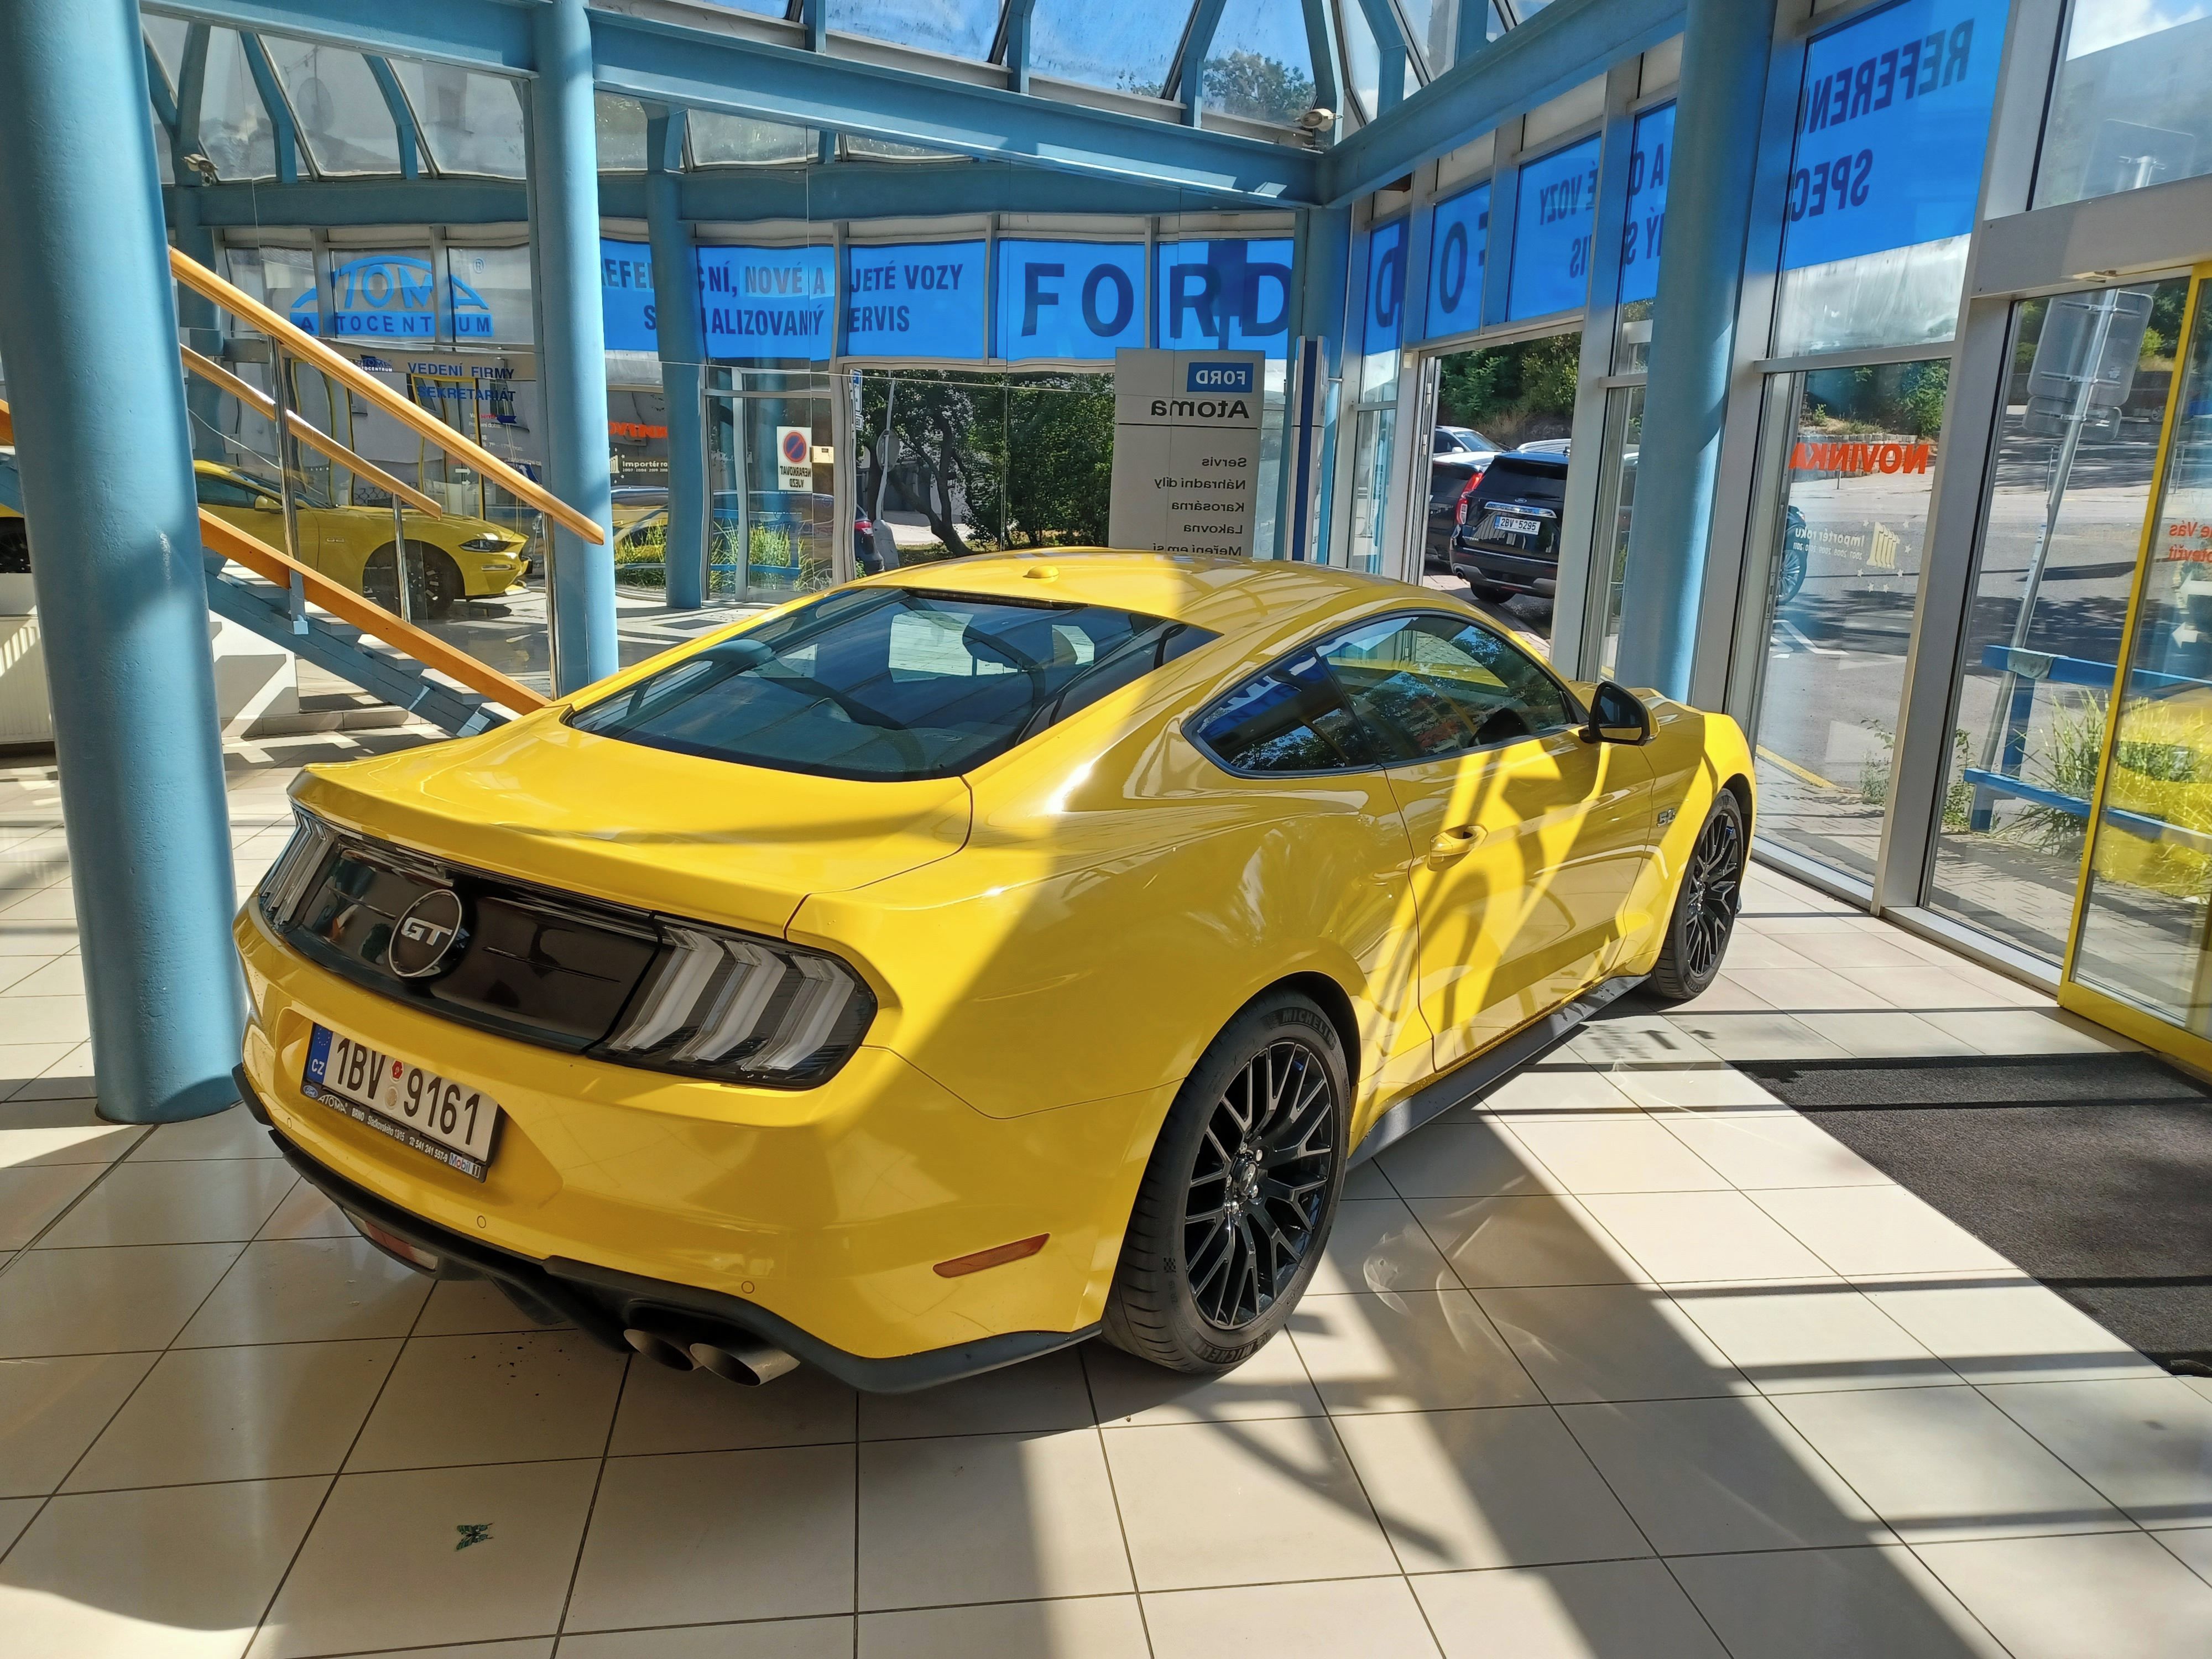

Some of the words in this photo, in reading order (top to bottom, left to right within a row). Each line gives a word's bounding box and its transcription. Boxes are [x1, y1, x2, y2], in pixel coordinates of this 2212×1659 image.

[745, 261, 803, 294] NOVÉ
[813, 267, 826, 295] A
[850, 260, 896, 293] JETÉ
[904, 263, 963, 290] VOZY
[1021, 262, 1292, 339] FORD
[299, 315, 491, 333] ATOCENTUM
[849, 305, 910, 333] ERVIS
[408, 361, 462, 377] VEDENÍ
[471, 366, 514, 379] FIRMY
[418, 385, 516, 401] SEKRETARIÁT
[1500, 518, 1515, 528] 2BV
[1519, 520, 1537, 531] 5295
[400, 917, 453, 946] GT
[1282, 1008, 1338, 1048] MICHELIN
[311, 1058, 325, 1076] CZ
[337, 1037, 387, 1100] 1BV
[404, 1068, 481, 1146] 9161
[317, 1094, 347, 1114] ATOMA
[351, 1108, 365, 1121] BRNO
[415, 1140, 425, 1151] 541
[425, 1144, 434, 1156] 241
[449, 1154, 471, 1173] Mobil
